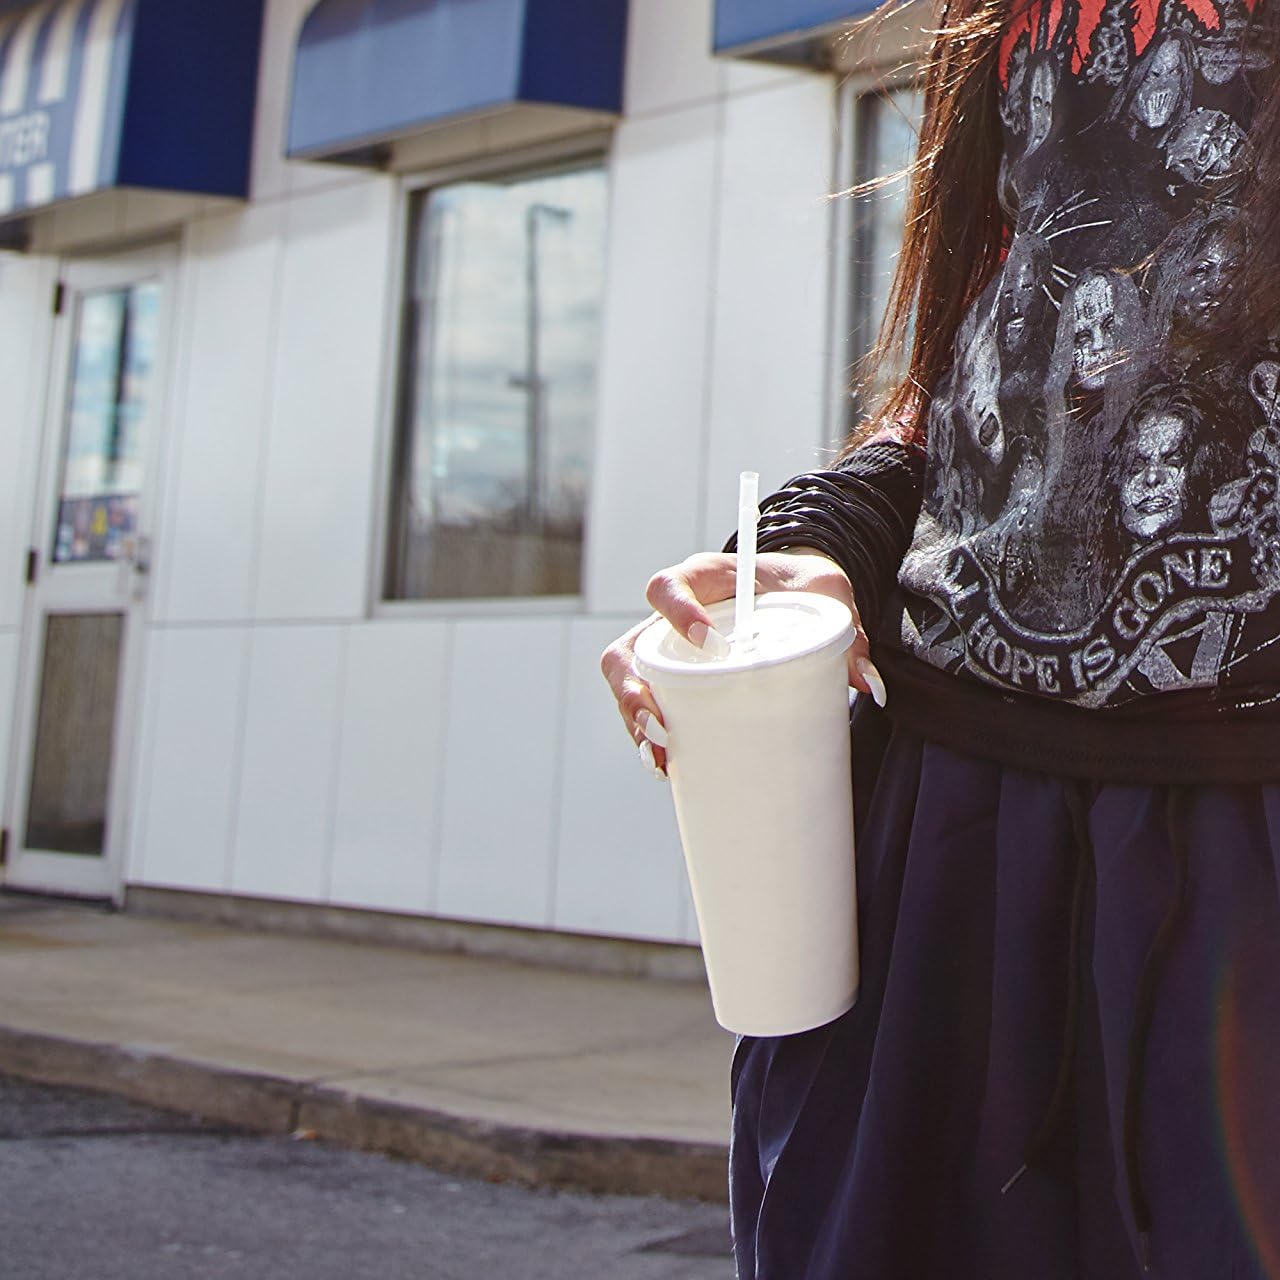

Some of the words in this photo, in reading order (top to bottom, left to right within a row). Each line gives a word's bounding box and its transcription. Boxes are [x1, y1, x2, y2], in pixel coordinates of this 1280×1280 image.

[967, 612, 1061, 694] HOPE
[1069, 633, 1115, 690] IS
[1112, 548, 1232, 640] GONE
